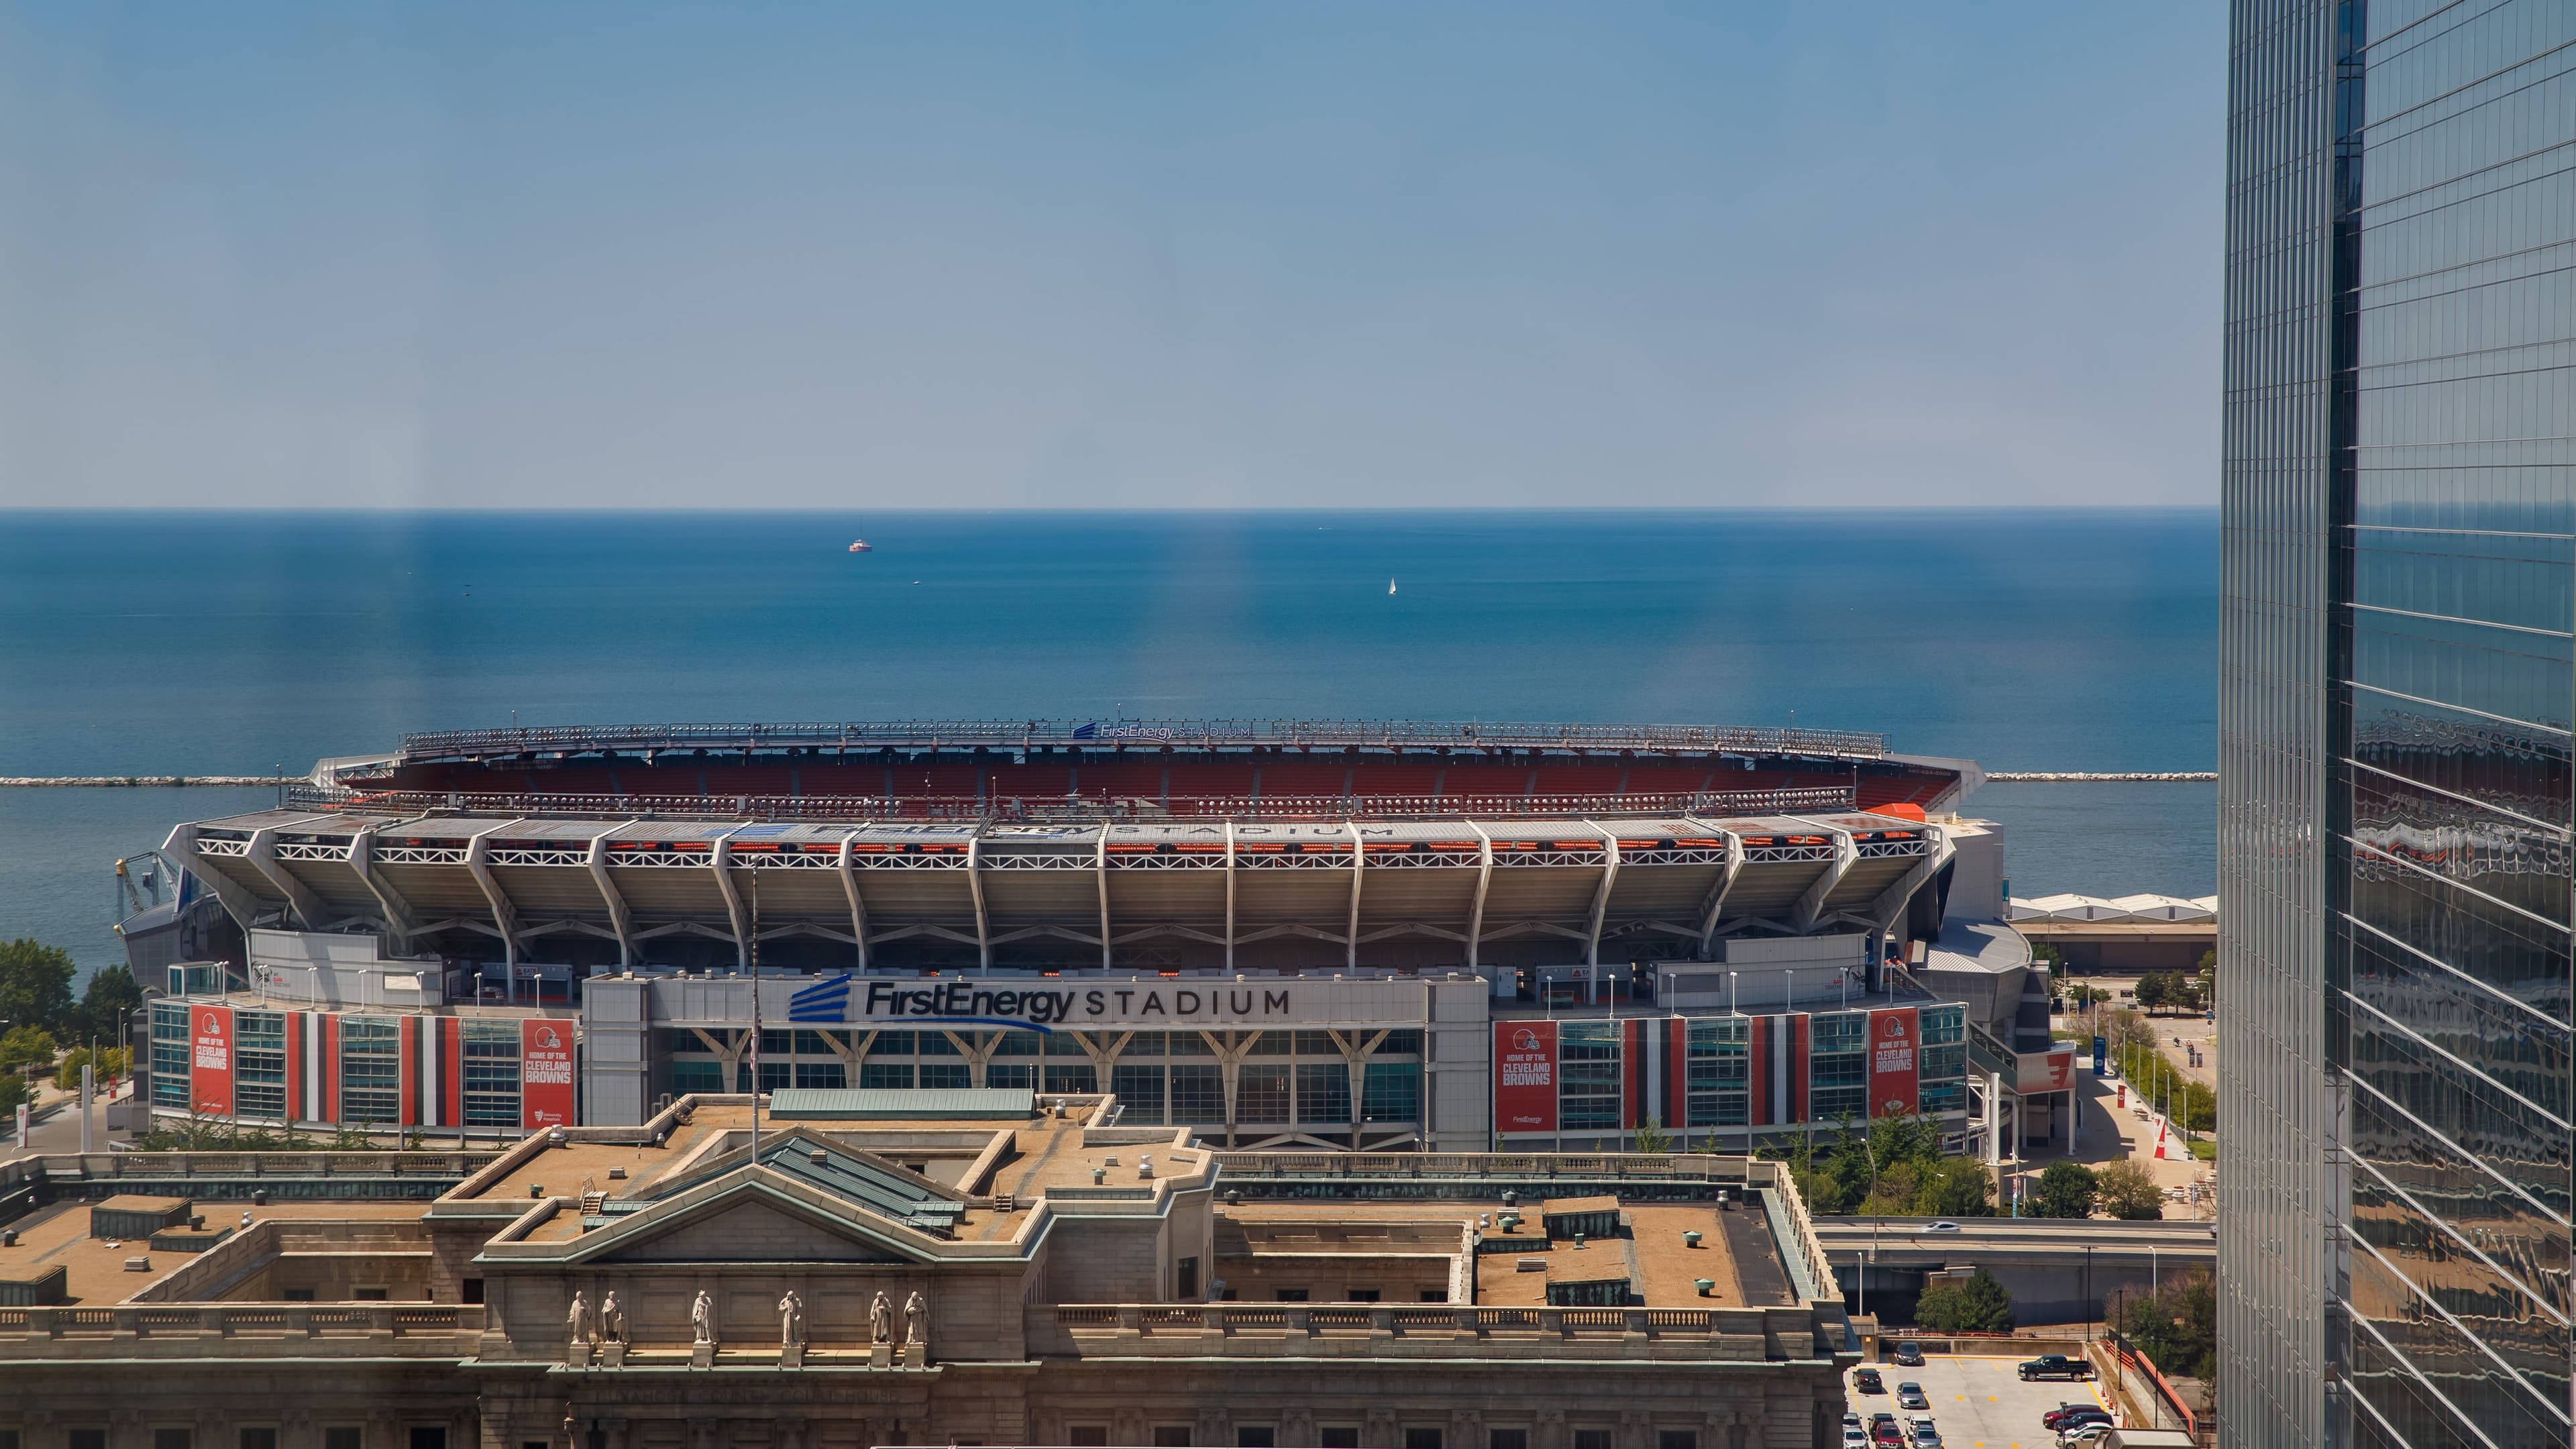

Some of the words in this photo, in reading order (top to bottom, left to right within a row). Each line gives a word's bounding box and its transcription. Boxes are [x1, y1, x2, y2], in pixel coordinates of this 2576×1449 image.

[1100, 724, 1174, 739] FirstEnergy
[1179, 727, 1250, 737] STADIUM
[1115, 826, 1393, 835] STADIUM
[865, 981, 1075, 1023] FirstEnergy
[1086, 989, 1289, 1016] STADIUM
[196, 1045, 227, 1057] CLEVELAND
[1876, 1049, 1912, 1061] CLEVELAND
[196, 1055, 227, 1070] BROWNS
[526, 1061, 570, 1071] CLEVELAND
[1503, 1063, 1550, 1073] CLEVELAND
[1876, 1059, 1912, 1073] BROWNS
[526, 1071, 571, 1084] BROWNS
[1503, 1073, 1550, 1085] BROWNS
